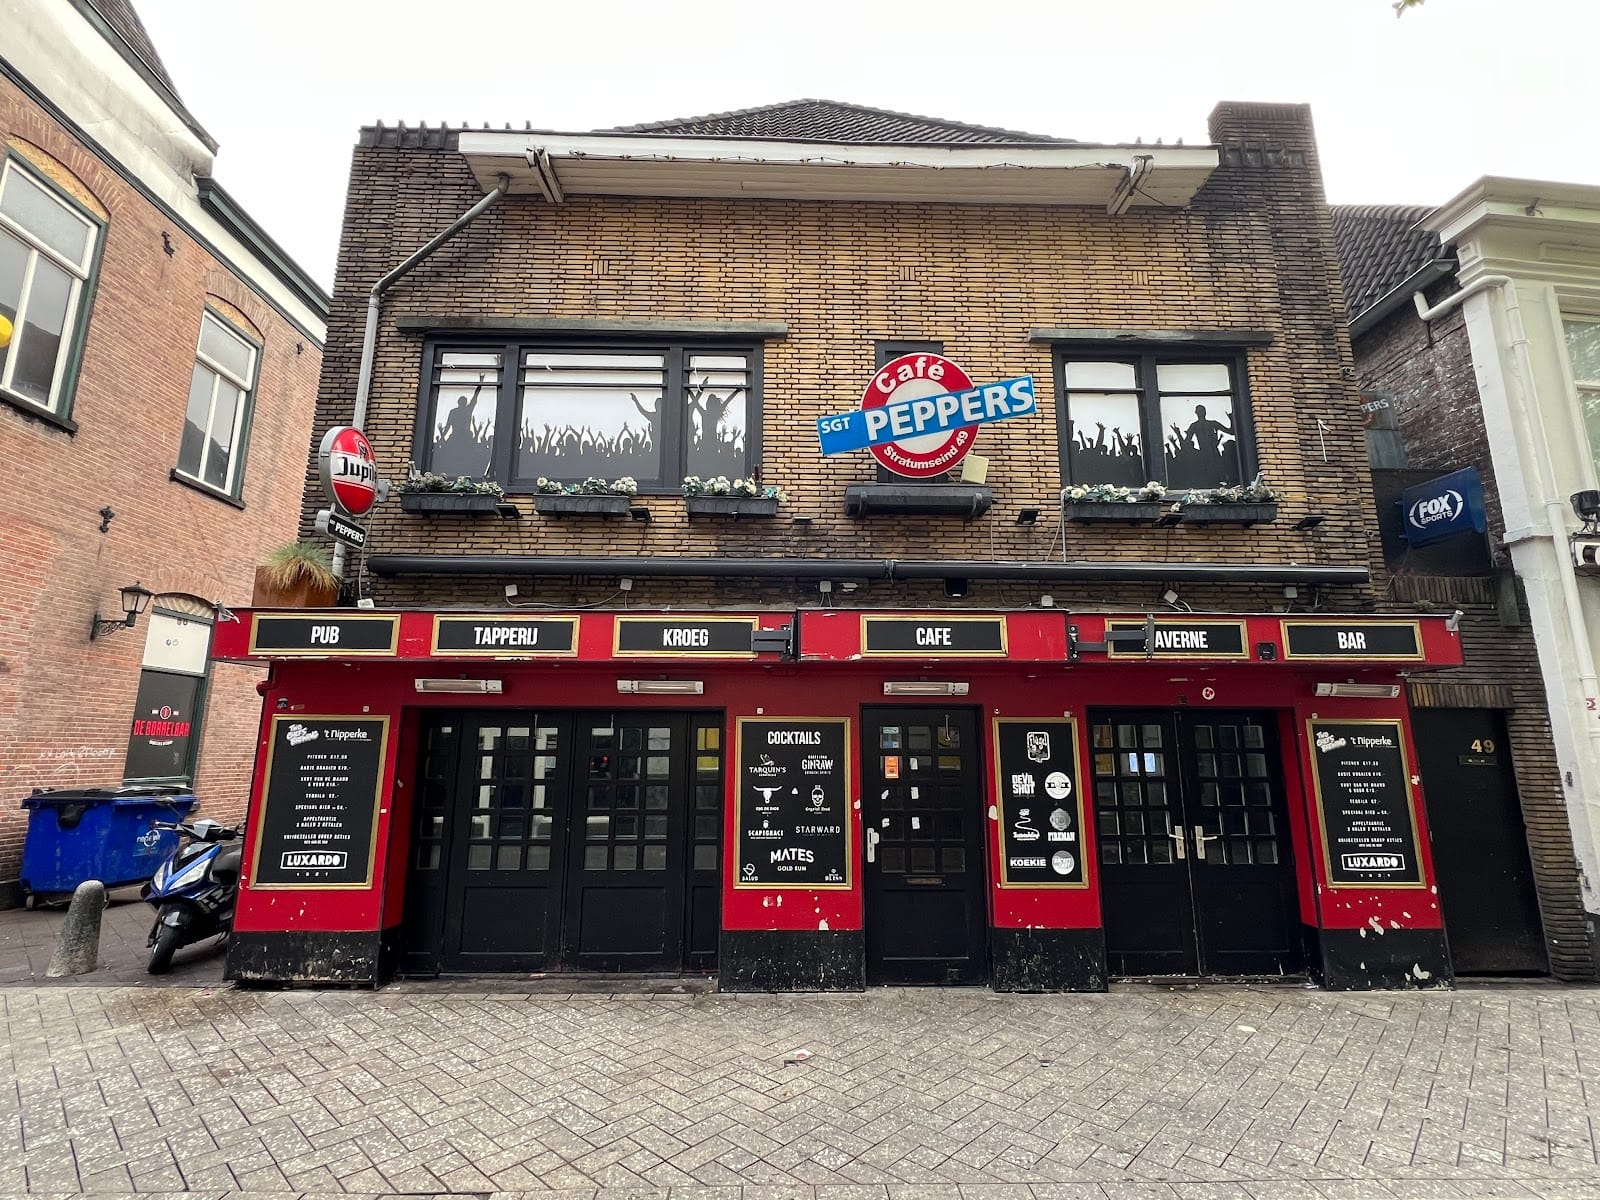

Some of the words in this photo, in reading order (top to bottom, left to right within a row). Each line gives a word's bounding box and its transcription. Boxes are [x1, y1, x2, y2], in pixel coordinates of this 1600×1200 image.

[875, 357, 945, 394] Café
[821, 417, 850, 434] SGT
[865, 381, 1033, 441] PEPPERS
[884, 446, 959, 469] Stratumseind
[956, 431, 969, 446] 49
[1418, 493, 1452, 519] FOX
[1420, 510, 1453, 524] SPORTS
[335, 522, 364, 543] PEPPERS
[311, 626, 340, 644] PUB
[474, 626, 538, 646] TAPPERIJ
[663, 628, 709, 647] KROEG
[916, 627, 952, 646] CAFE
[1154, 630, 1209, 649] AVERNE
[1337, 631, 1367, 650] BAR
[134, 720, 145, 736] DE
[145, 721, 191, 737] BORRELBAR
[767, 730, 821, 745] COCKTAILS
[1471, 739, 1496, 754] 49
[748, 766, 787, 774] TARQUIN'S
[801, 759, 834, 770] GINRAW
[1011, 771, 1034, 784] DEVIL
[1012, 783, 1036, 796] SHOT
[795, 825, 841, 834] STARWARD
[286, 854, 341, 867] LUXARDO
[770, 847, 815, 864] MATES
[1009, 858, 1047, 867] KOEKIE
[1346, 856, 1399, 868] LUXARDO
